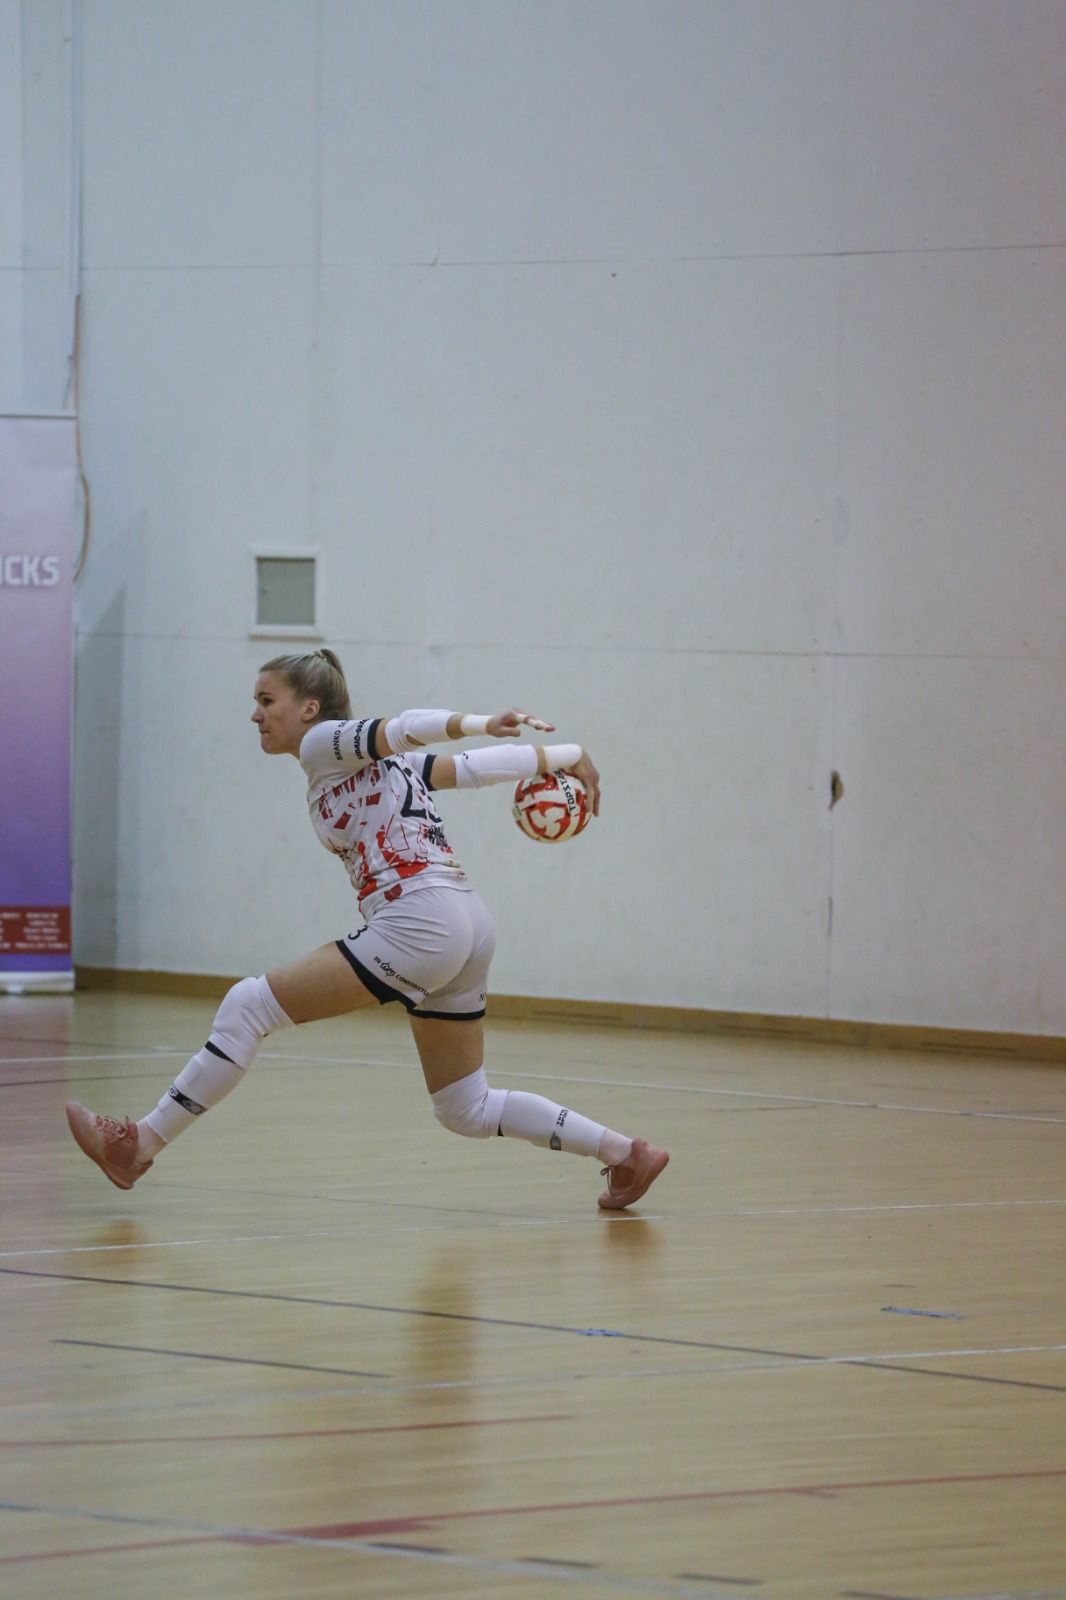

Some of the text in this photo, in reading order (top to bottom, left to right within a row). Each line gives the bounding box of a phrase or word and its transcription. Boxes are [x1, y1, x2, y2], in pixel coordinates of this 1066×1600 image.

[333, 730, 344, 761] BRANKO
[554, 767, 576, 812] TOPSTAR
[373, 956, 382, 964] IN
